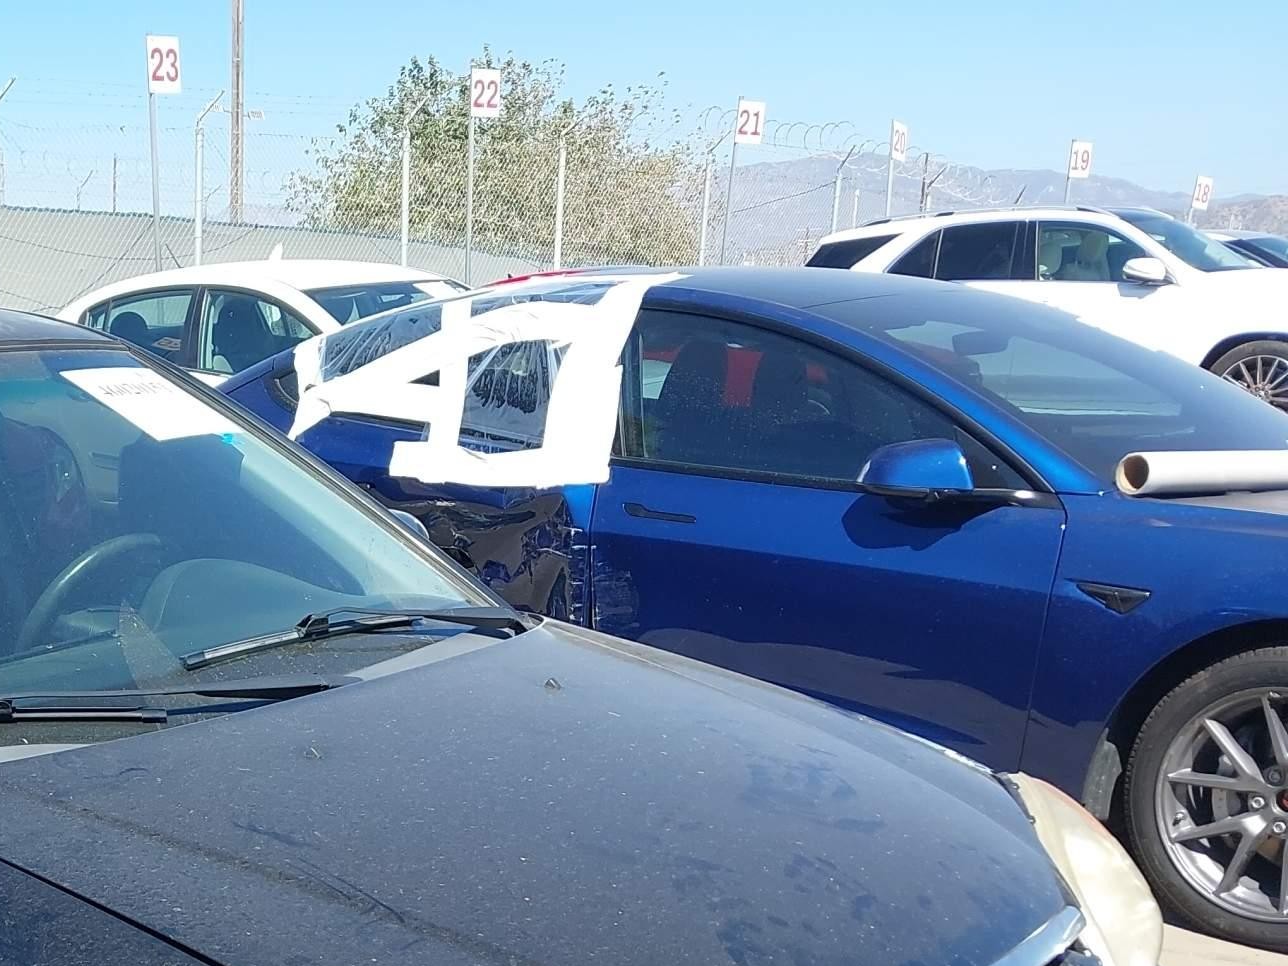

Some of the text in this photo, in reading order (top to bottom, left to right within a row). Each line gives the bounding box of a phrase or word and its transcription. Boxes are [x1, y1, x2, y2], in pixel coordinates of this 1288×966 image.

[150, 47, 179, 83] 23
[473, 79, 499, 109] 22
[738, 109, 761, 136] 21
[893, 129, 906, 155] 20
[1071, 150, 1090, 171] 19
